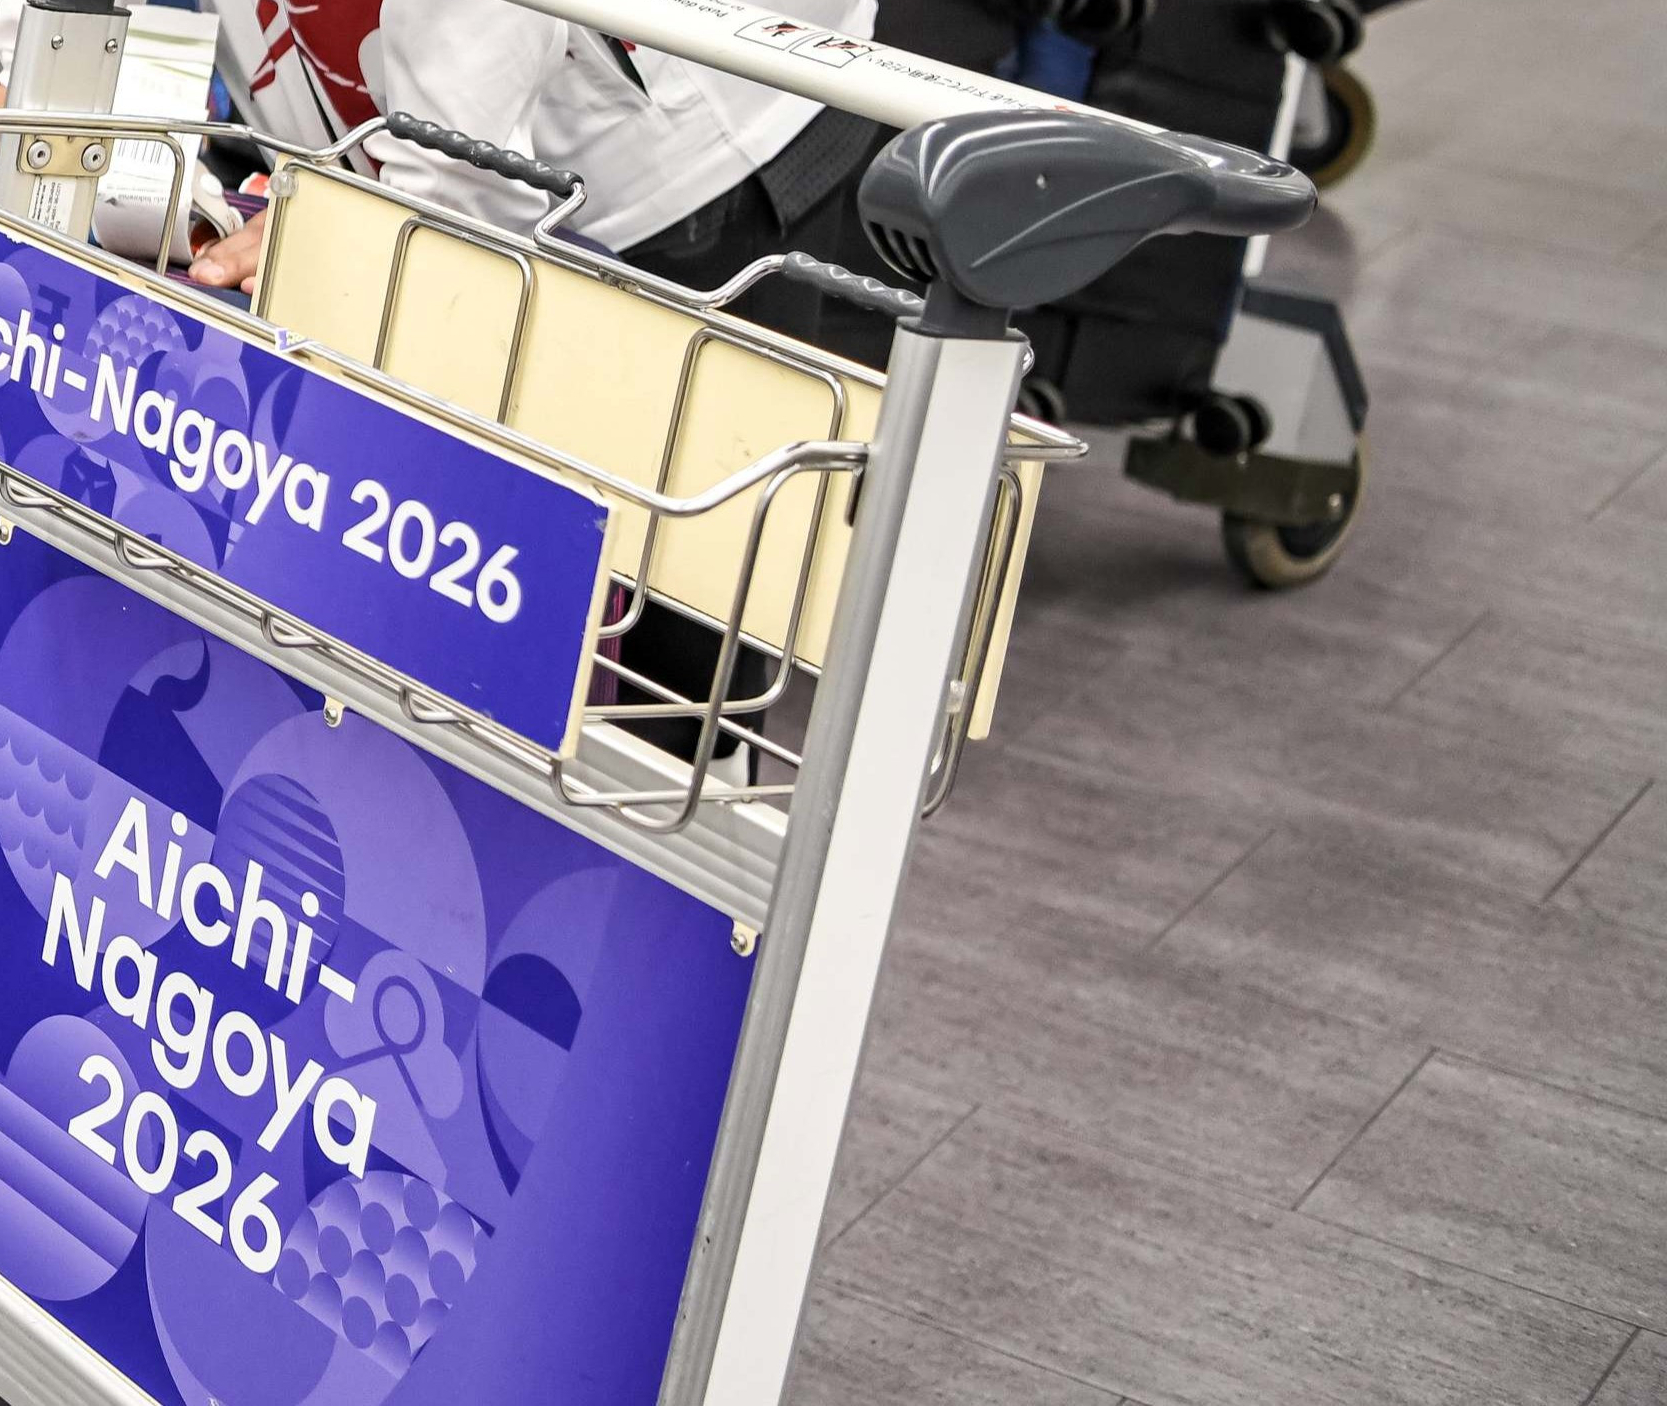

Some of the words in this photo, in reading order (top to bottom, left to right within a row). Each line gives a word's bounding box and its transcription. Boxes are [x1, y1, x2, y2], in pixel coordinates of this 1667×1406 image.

[698, 6, 728, 18] Push
[341, 479, 521, 624] 2026
[93, 796, 357, 1005] Aichi-
[42, 870, 378, 1180] Nagoya
[67, 1054, 283, 1274] 2026
